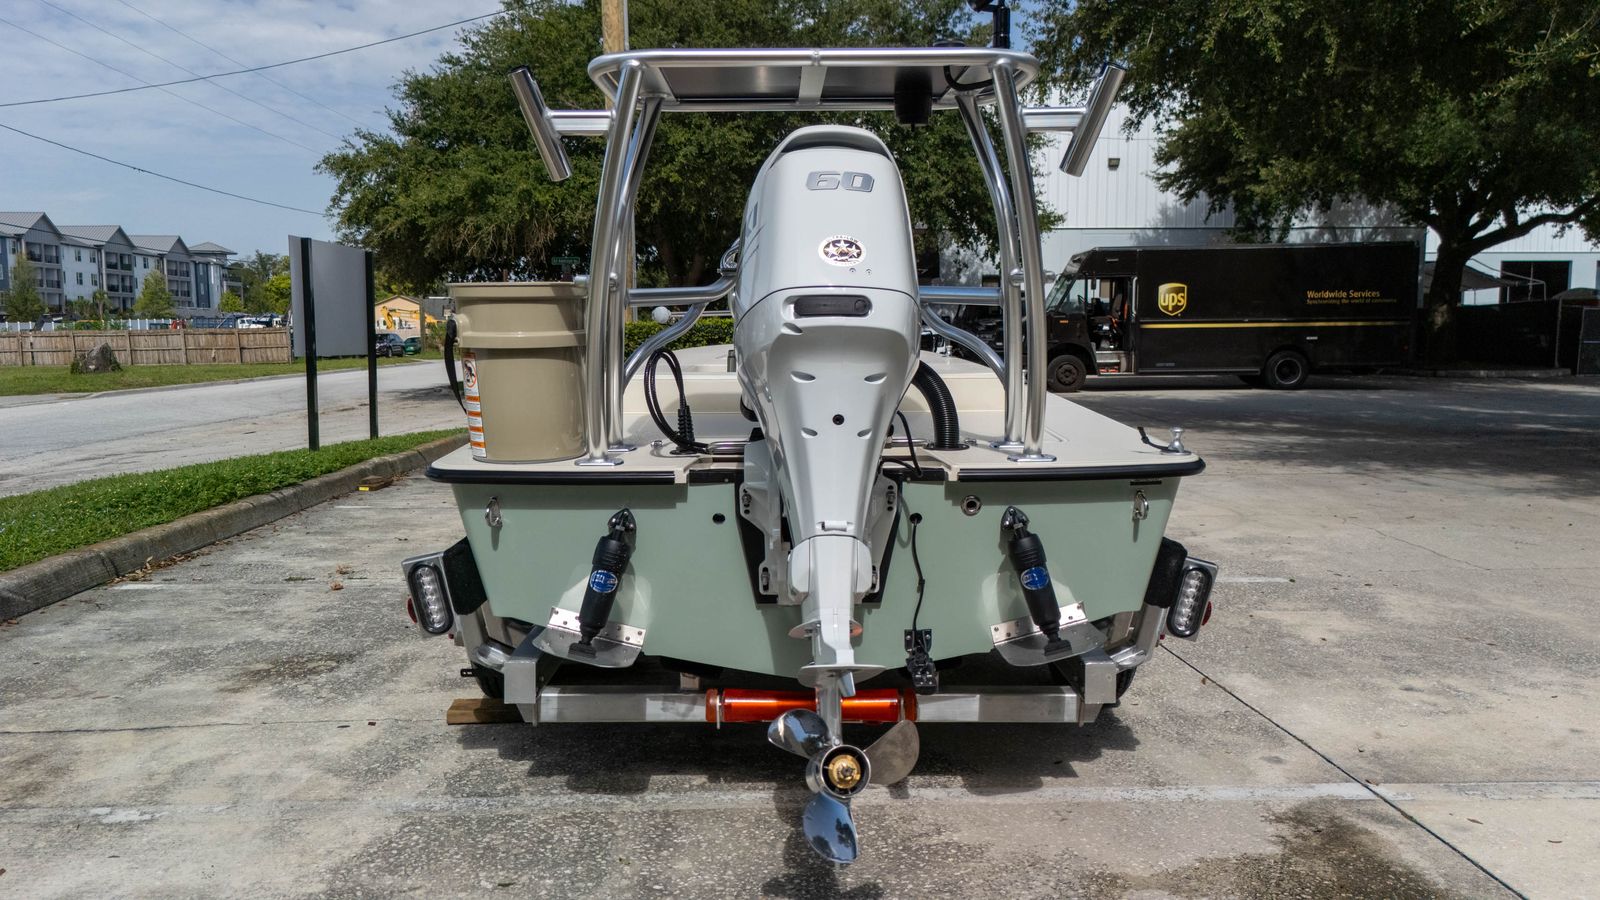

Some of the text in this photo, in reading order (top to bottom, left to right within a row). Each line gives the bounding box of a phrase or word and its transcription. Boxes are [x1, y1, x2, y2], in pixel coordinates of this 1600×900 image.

[806, 171, 874, 192] 60
[1160, 293, 1185, 311] ups
[1306, 289, 1380, 298] Worldwide Services
